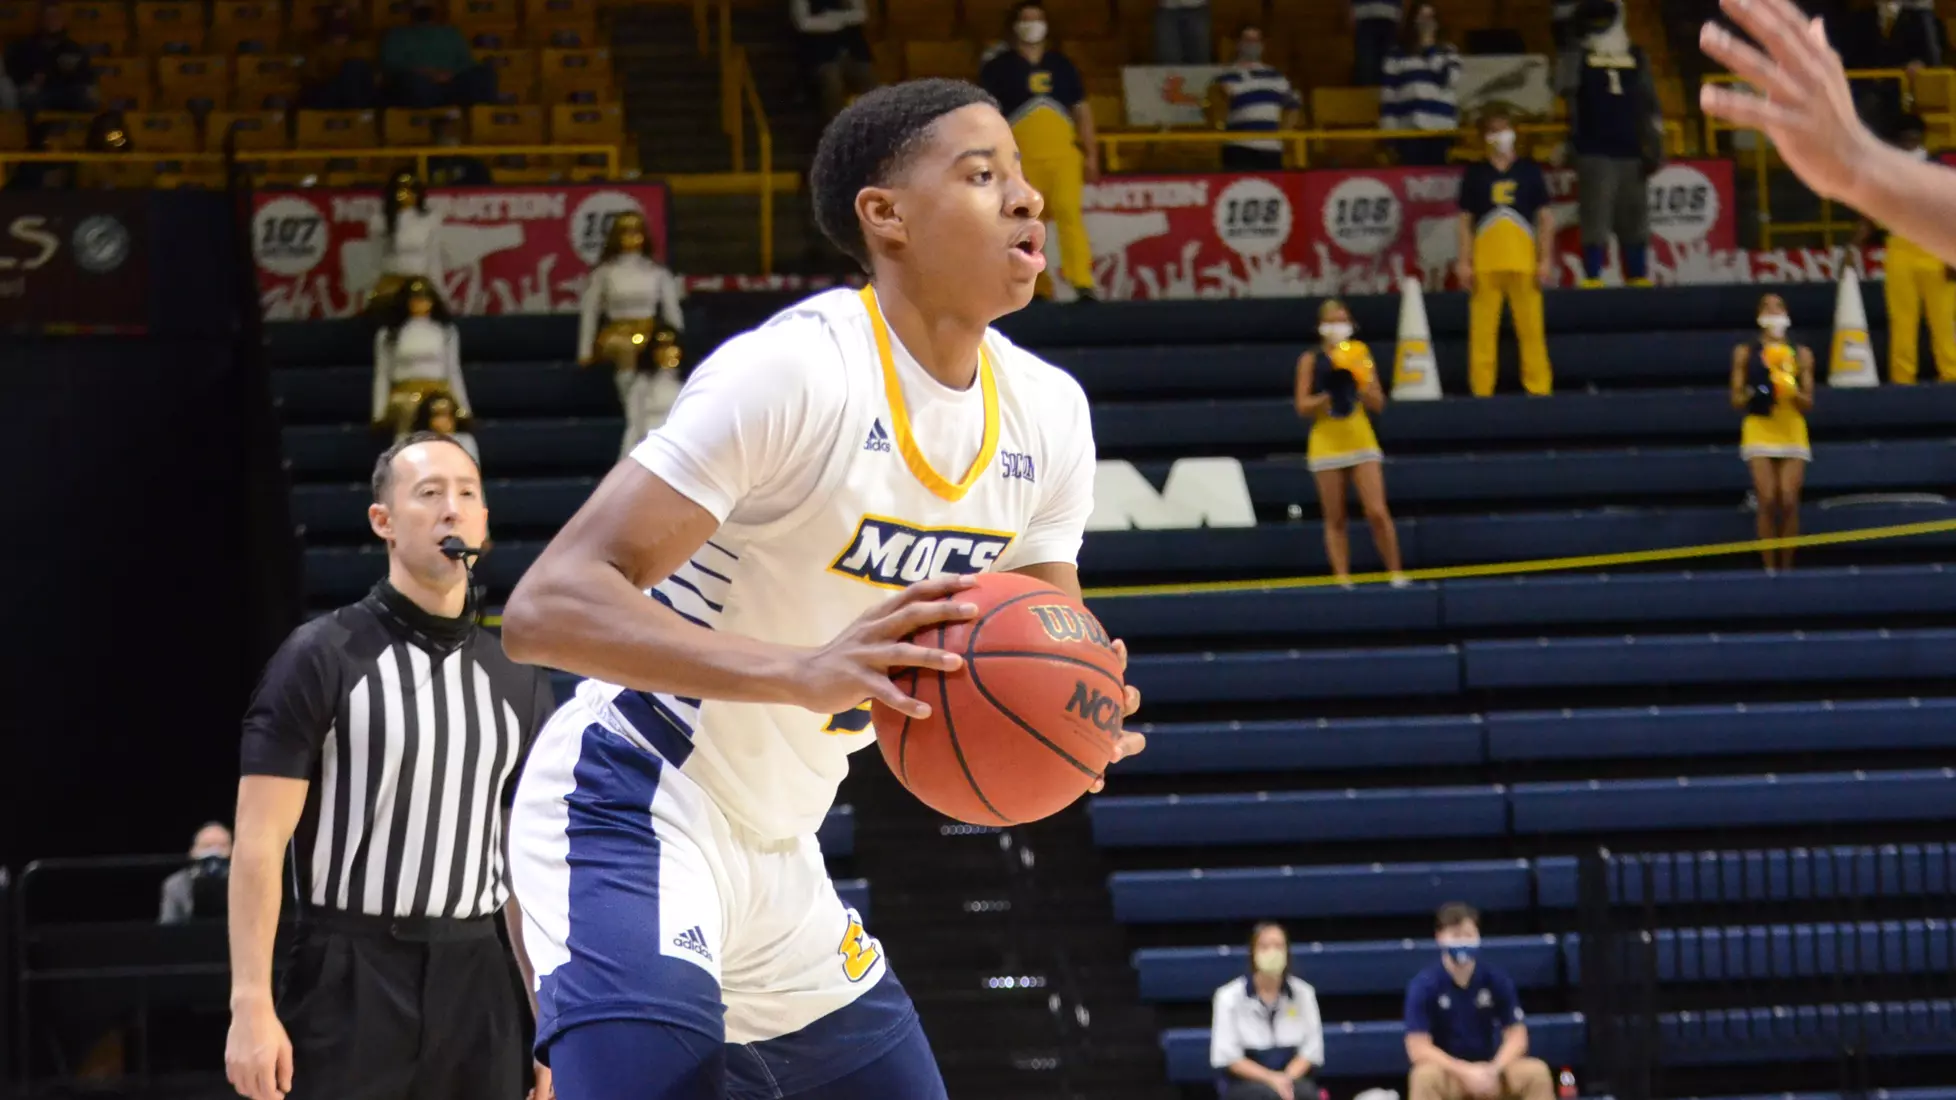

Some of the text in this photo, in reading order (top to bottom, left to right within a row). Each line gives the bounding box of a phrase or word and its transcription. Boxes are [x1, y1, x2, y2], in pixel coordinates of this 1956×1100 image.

[1228, 199, 1280, 224] 108
[1337, 198, 1390, 223] 108
[263, 218, 321, 242] 107
[863, 438, 891, 452] didas
[842, 525, 1006, 584] MOCS
[1065, 680, 1122, 739] NCA
[672, 936, 714, 963] adidas
